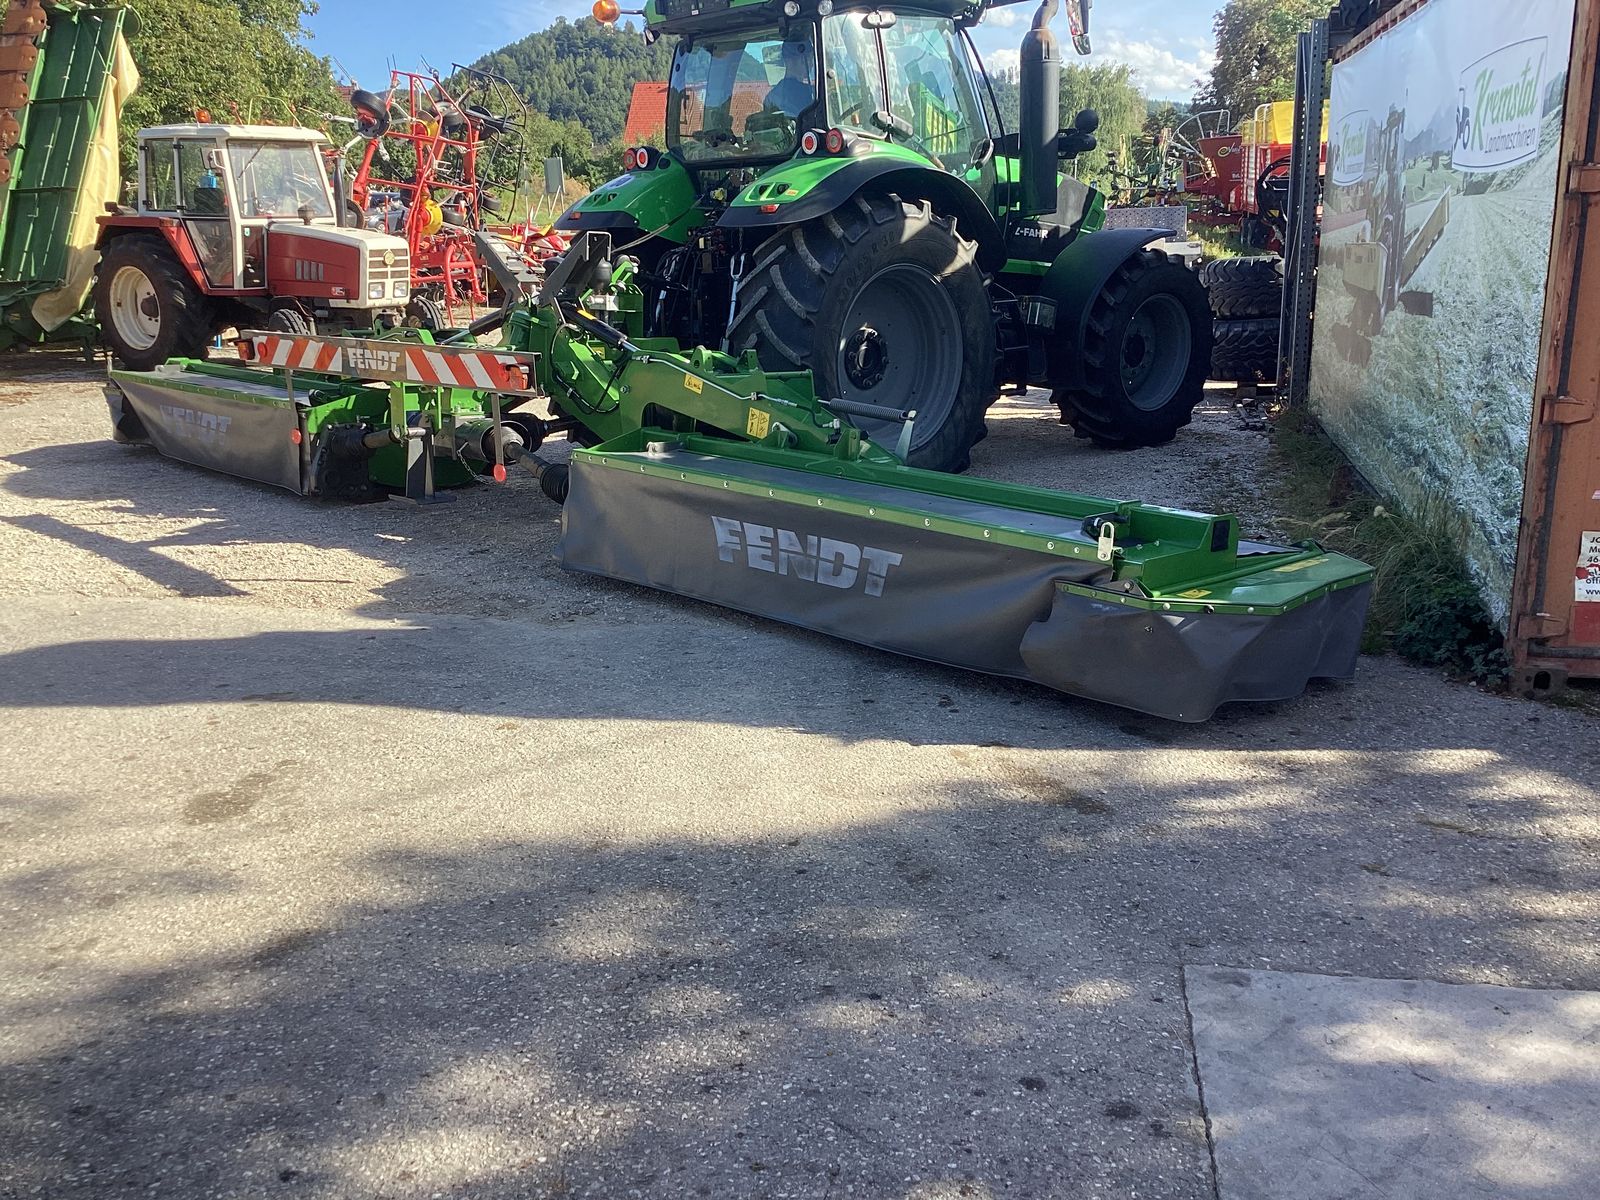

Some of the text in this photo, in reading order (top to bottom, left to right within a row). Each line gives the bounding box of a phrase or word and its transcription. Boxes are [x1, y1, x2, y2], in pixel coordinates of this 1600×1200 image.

[1470, 51, 1545, 151] Kremstal
[1484, 123, 1536, 154] Landmaschinen
[346, 347, 401, 372] FENDT
[160, 404, 232, 446] FENDT
[711, 515, 904, 598] FENDT
